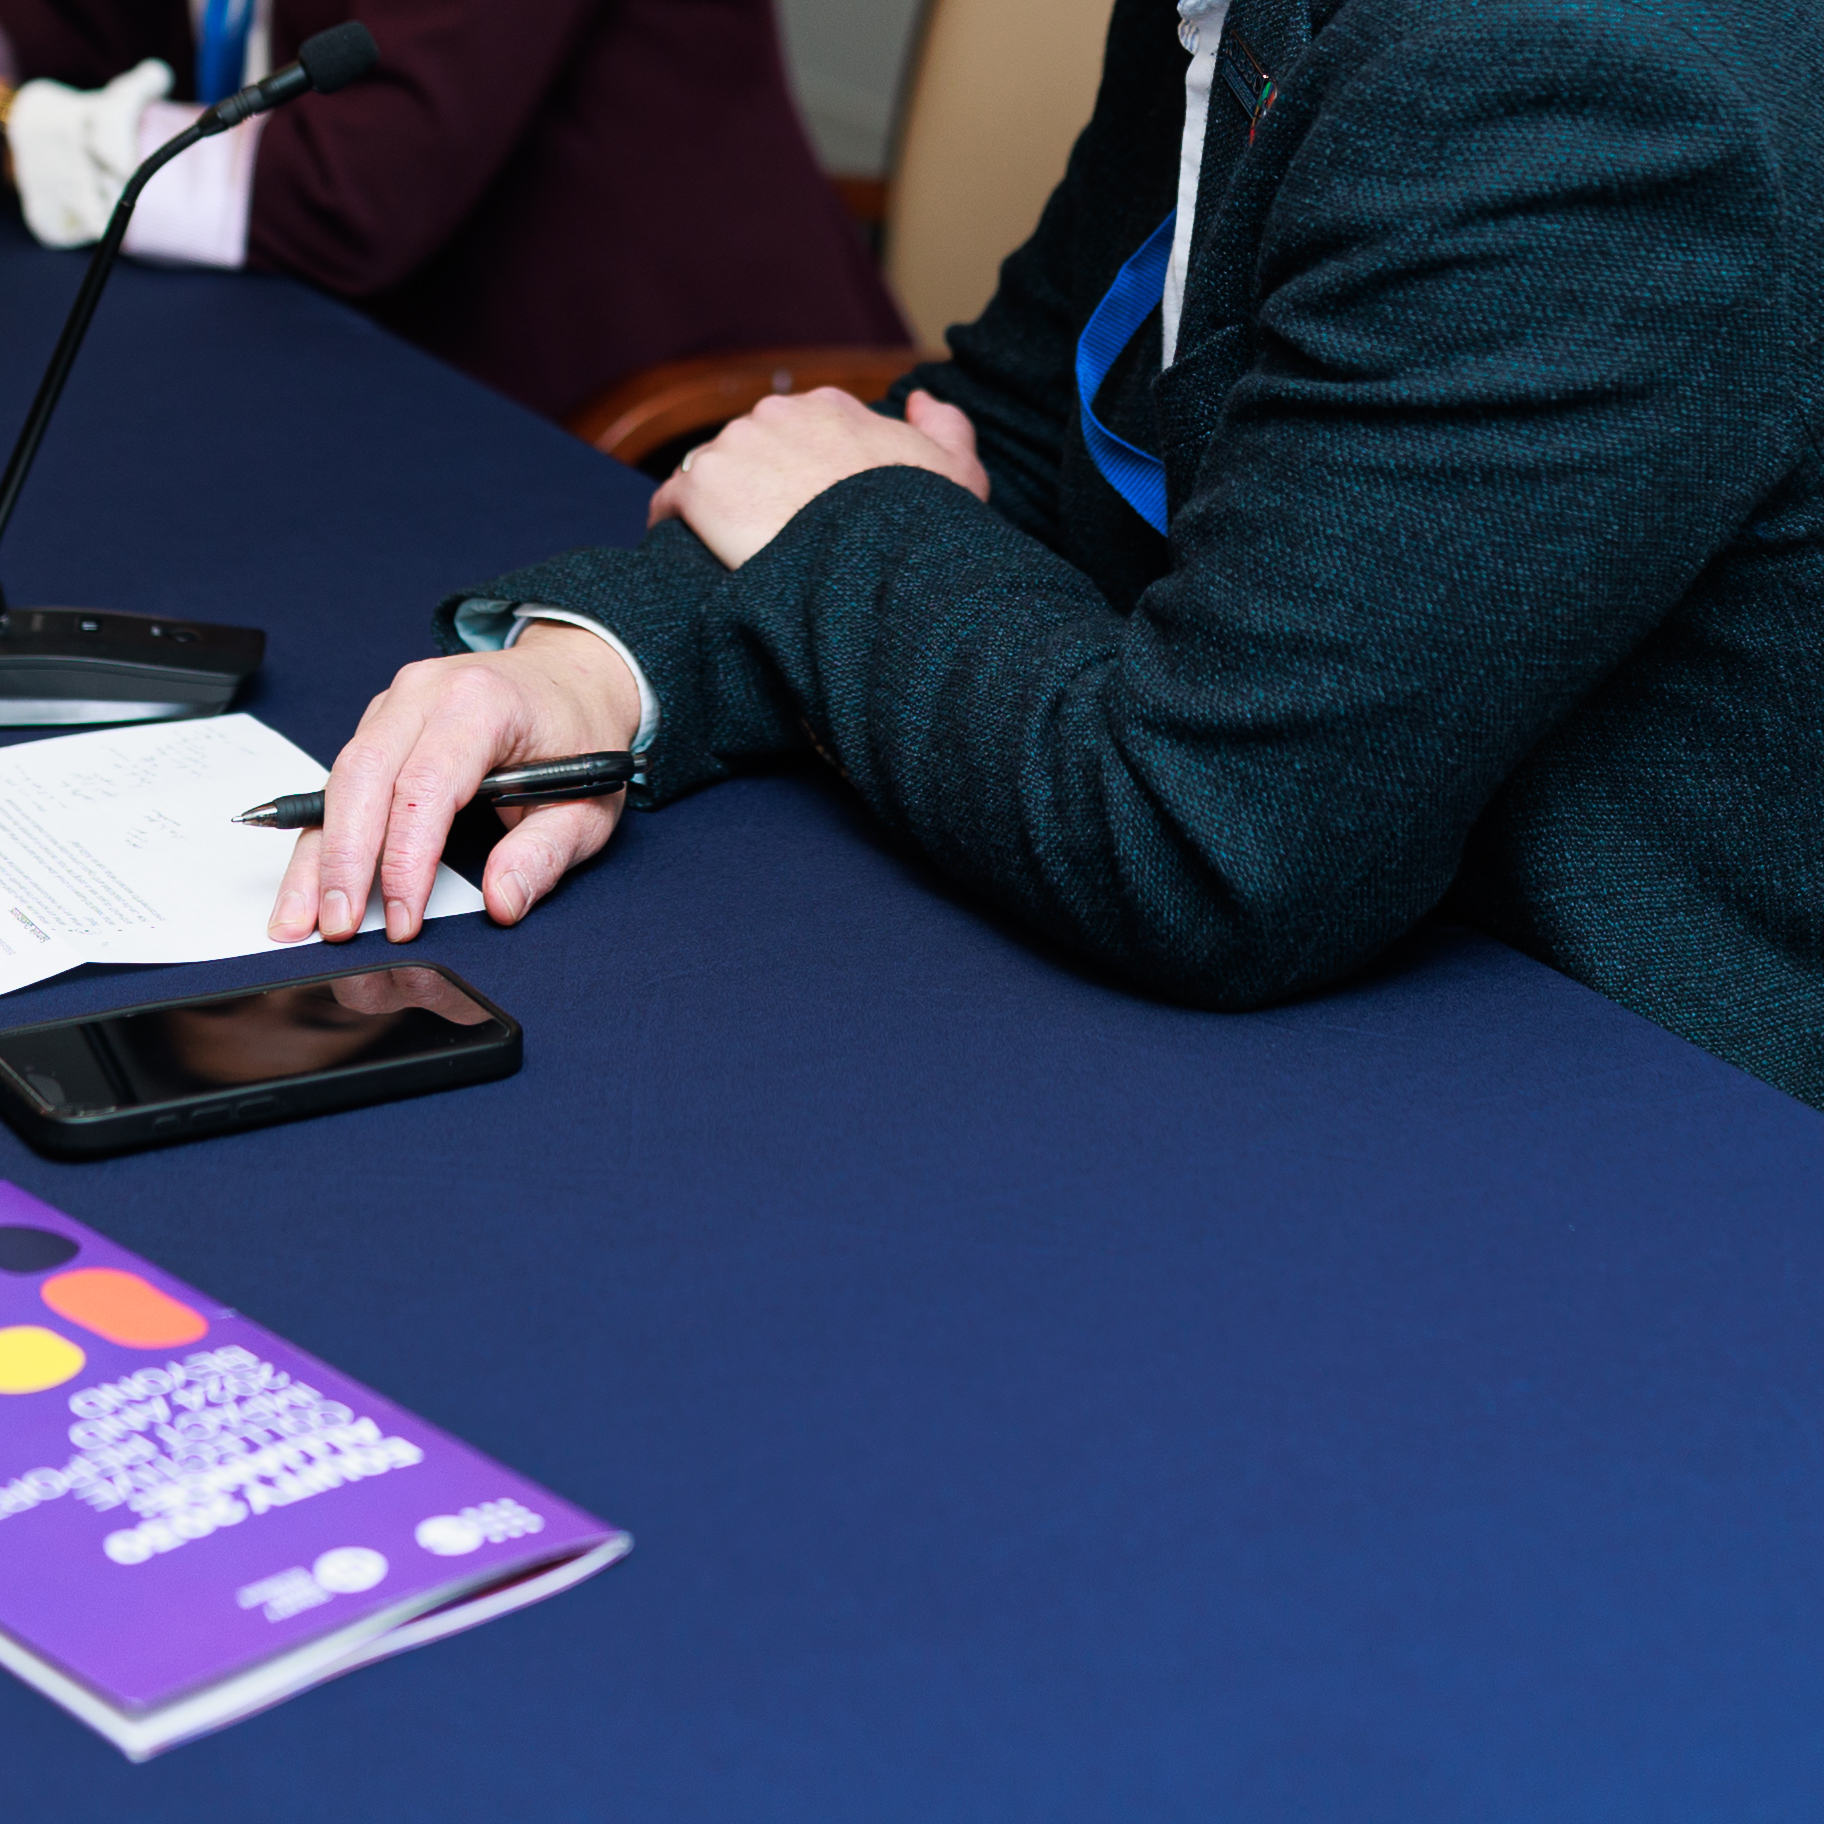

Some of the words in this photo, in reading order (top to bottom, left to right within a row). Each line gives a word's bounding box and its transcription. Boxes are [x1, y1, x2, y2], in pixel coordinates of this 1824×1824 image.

[67, 1344, 263, 1419] BEYOND
[151, 1381, 326, 1453] IMPACT
[169, 1363, 295, 1413] 2024
[65, 1396, 174, 1450] AND
[74, 1400, 357, 1511] COLLECTIVE
[240, 1436, 426, 1514] EQUITY
[103, 1494, 249, 1565] 2030
